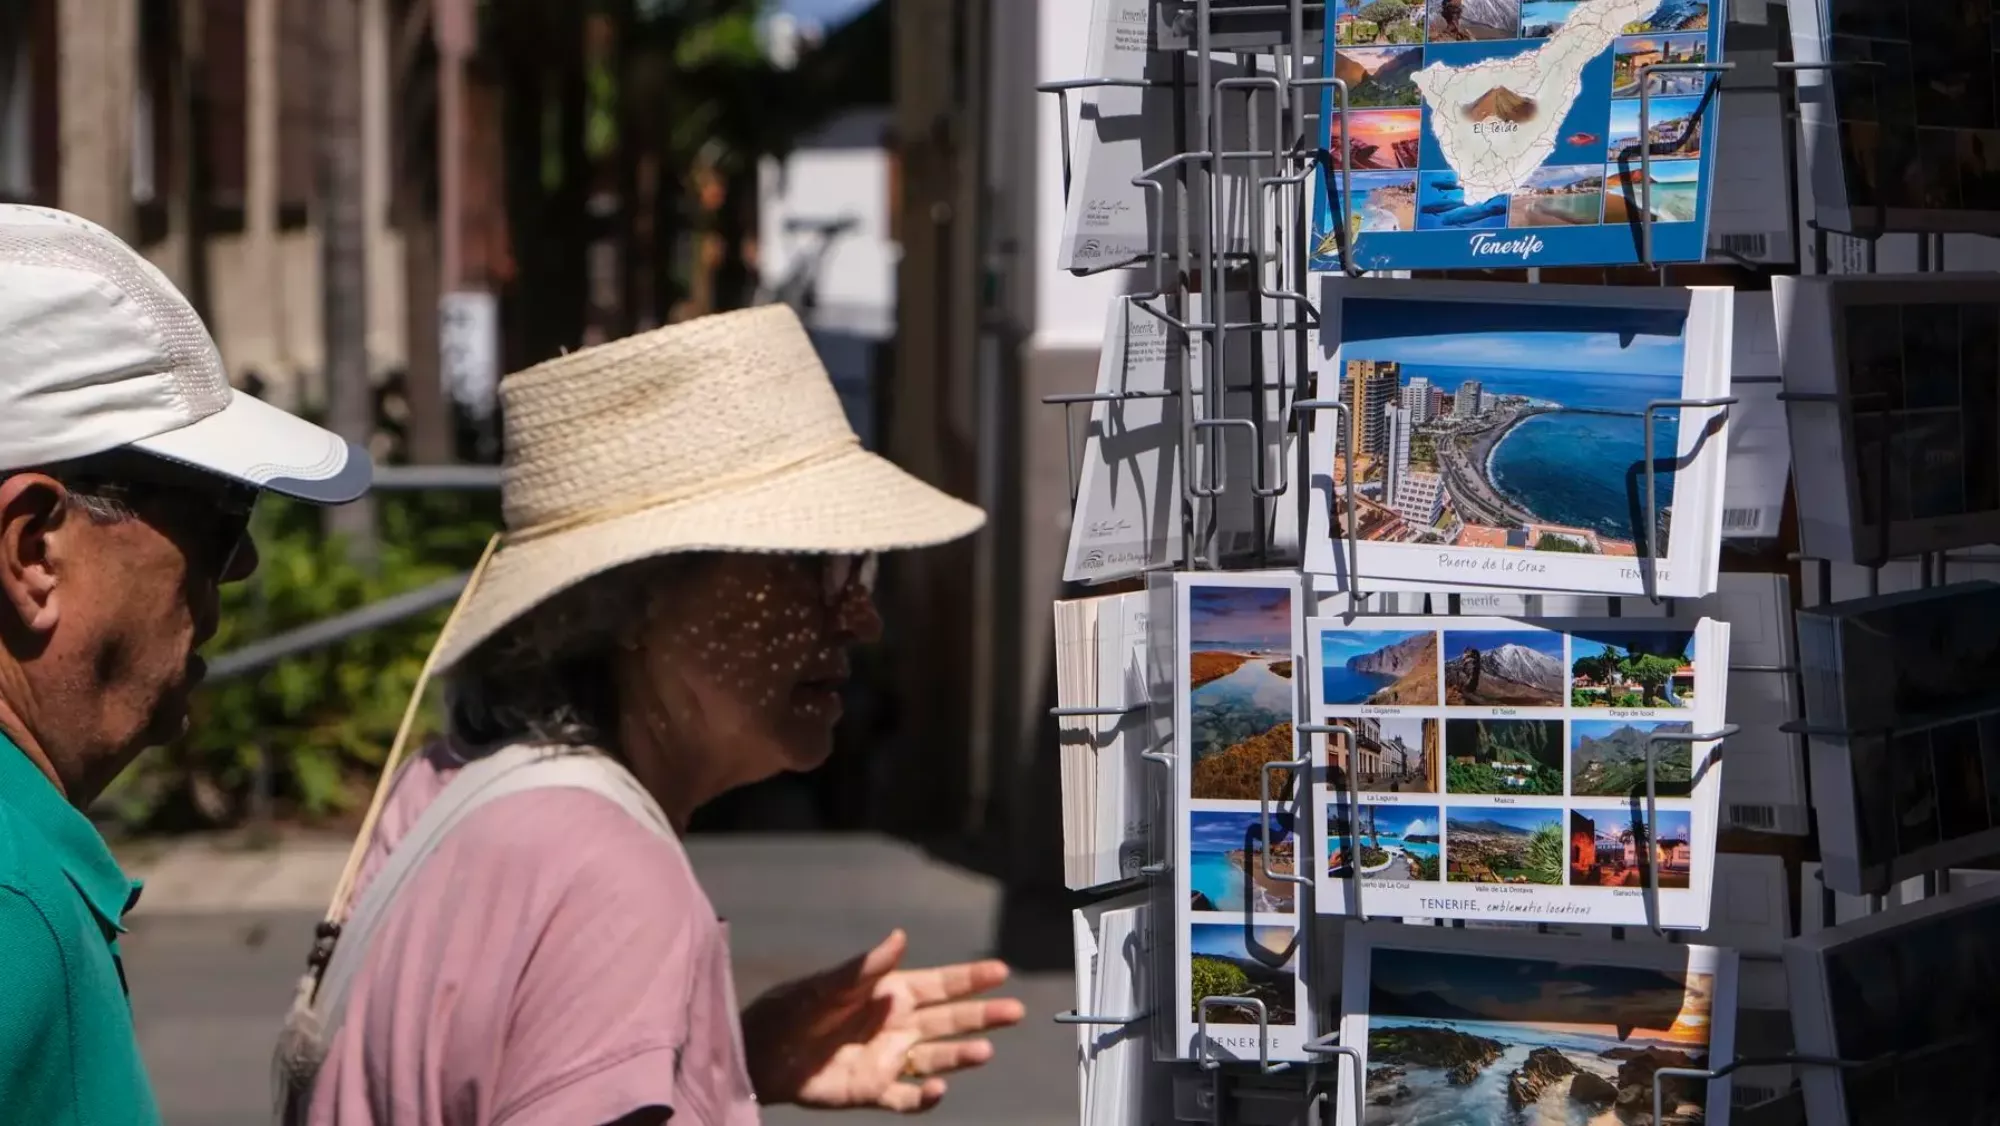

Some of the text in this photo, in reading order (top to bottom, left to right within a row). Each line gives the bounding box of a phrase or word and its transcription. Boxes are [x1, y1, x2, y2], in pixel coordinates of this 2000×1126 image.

[1473, 121, 1518, 134] El Teide
[1469, 233, 1544, 260] Tenerife
[1438, 554, 1546, 573] Puerto de la Cruz
[1460, 594, 1500, 606] enerife
[1373, 707, 1401, 716] Gigantes
[1609, 710, 1629, 718] Drago
[1376, 795, 1398, 803] Laguna
[1420, 898, 1592, 915] TENERIFE, emblematic locations
